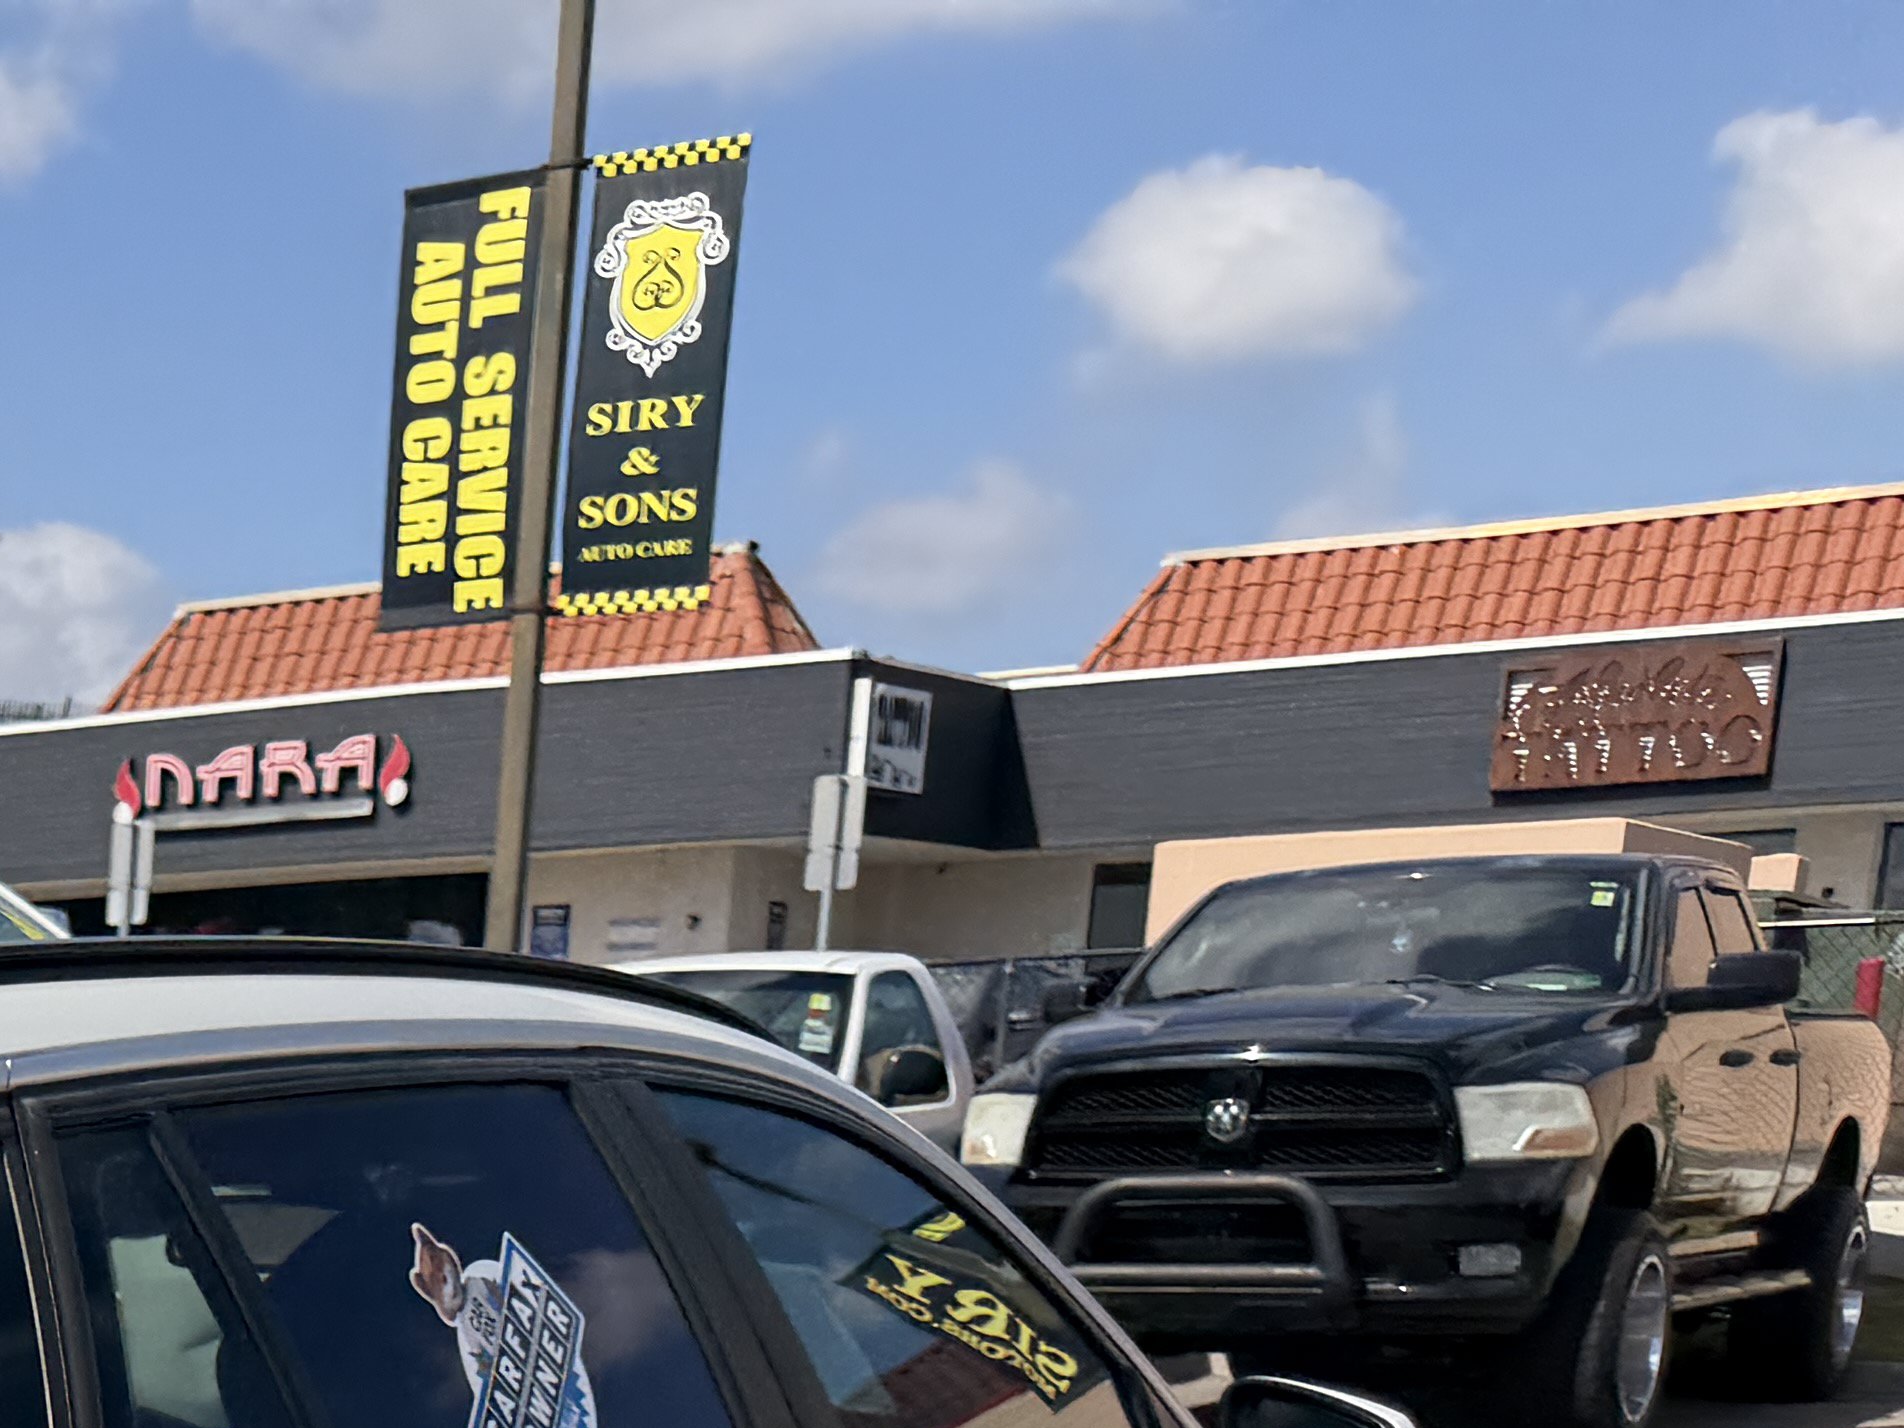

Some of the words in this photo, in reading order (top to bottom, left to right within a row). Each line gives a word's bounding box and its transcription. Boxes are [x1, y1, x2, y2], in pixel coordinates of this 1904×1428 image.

[469, 186, 531, 329] FULL
[406, 241, 466, 404] AUTO
[586, 394, 706, 436] SIRY
[397, 417, 452, 578] CARE
[453, 352, 516, 614] SERVICE
[620, 447, 660, 476] &
[578, 488, 698, 529] SONS
[578, 543, 634, 562] AUTO
[144, 733, 379, 806] NARA
